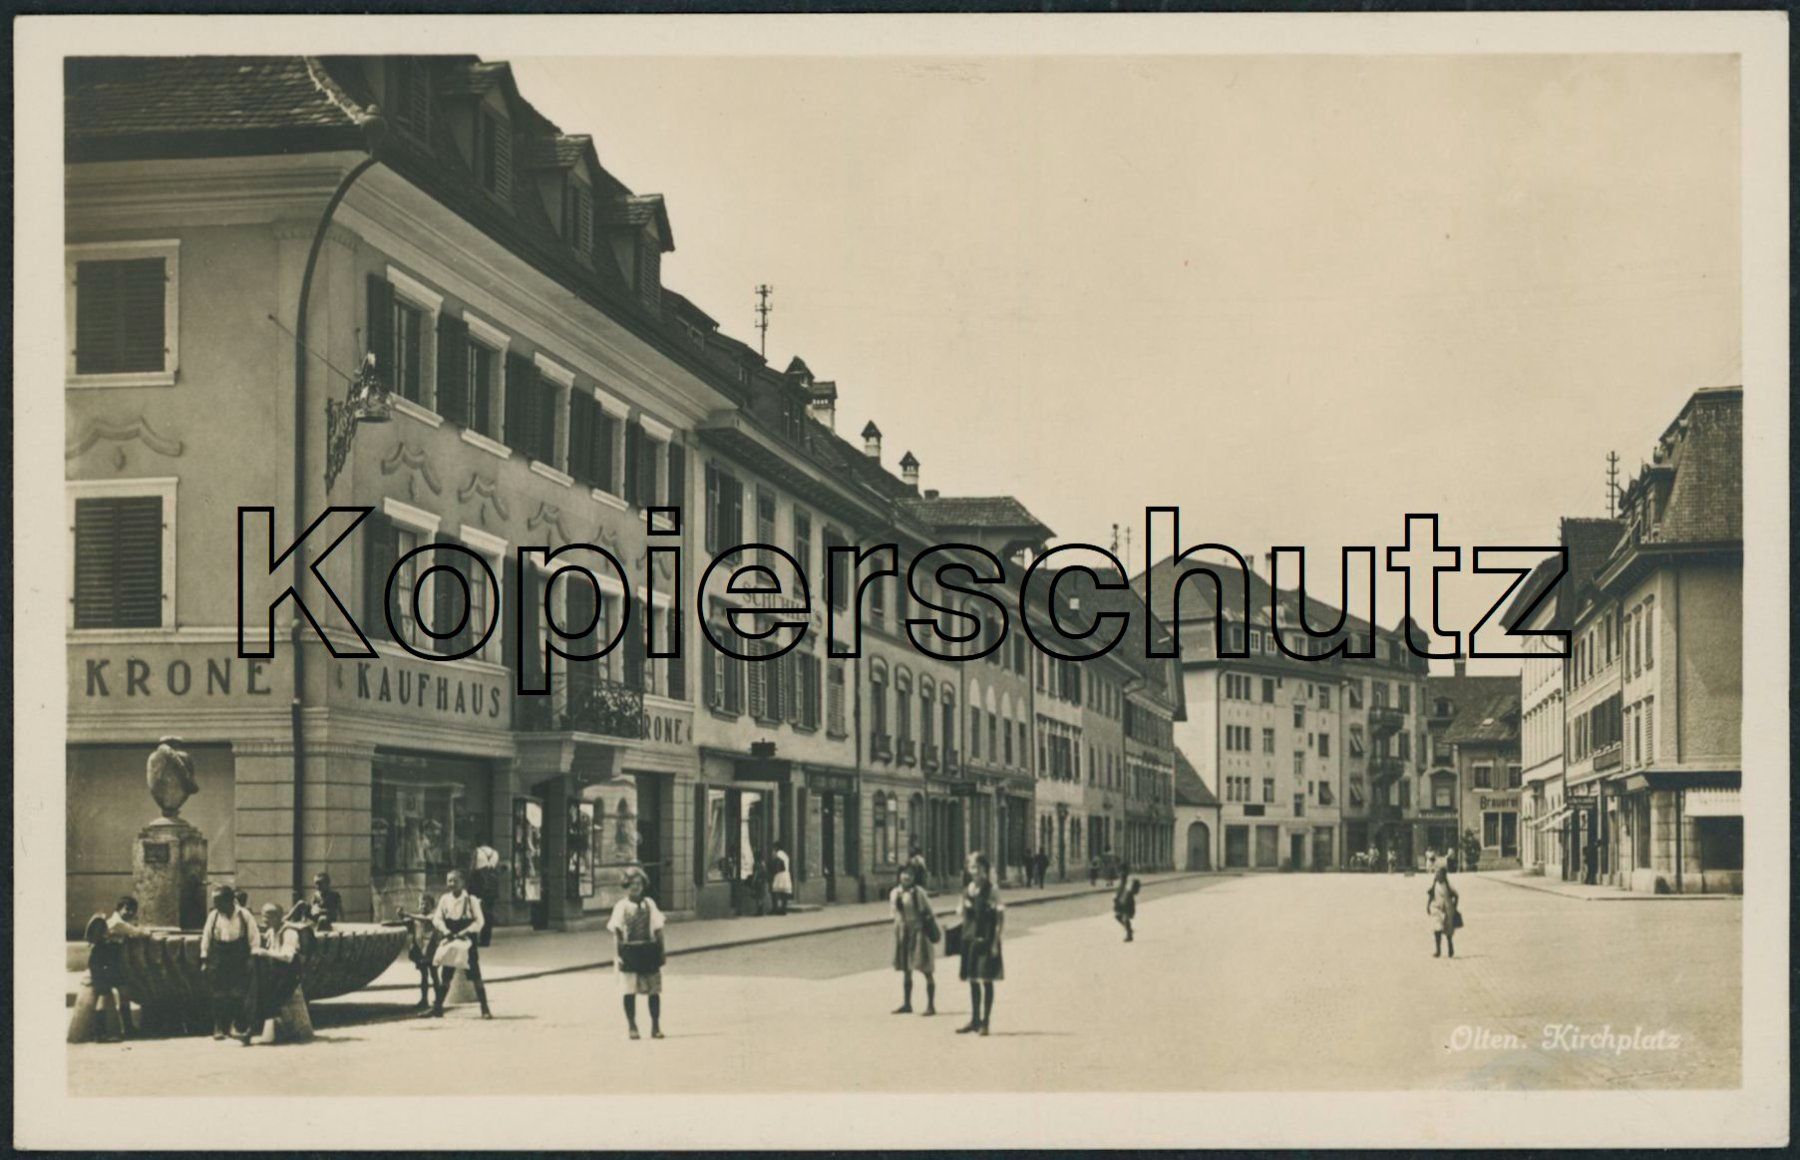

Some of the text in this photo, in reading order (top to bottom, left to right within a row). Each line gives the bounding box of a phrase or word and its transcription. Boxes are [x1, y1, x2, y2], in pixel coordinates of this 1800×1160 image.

[86, 658, 272, 696] KRONE
[357, 662, 501, 718] KAUFHAUS
[641, 713, 682, 745] RONE
